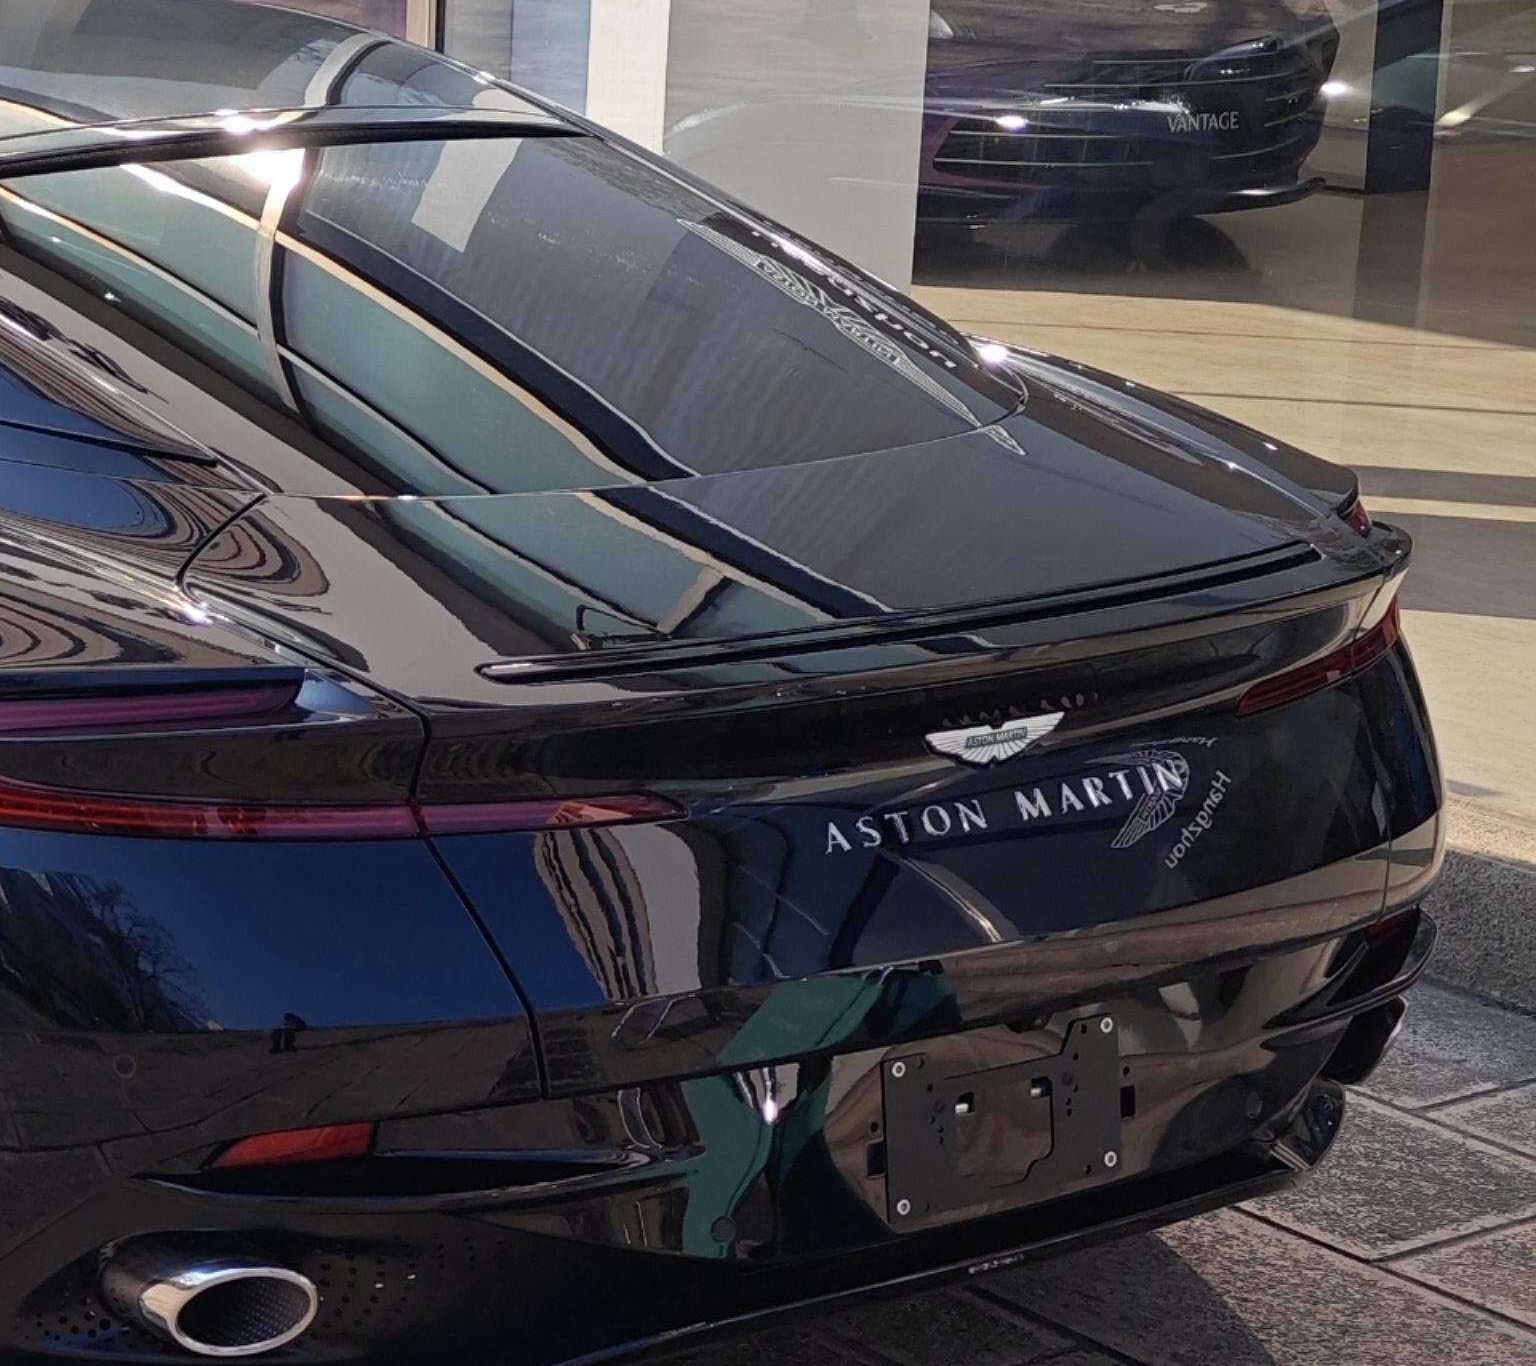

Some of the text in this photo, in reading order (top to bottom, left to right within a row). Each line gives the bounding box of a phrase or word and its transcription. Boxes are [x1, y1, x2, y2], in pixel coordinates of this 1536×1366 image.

[1167, 111, 1239, 133] VANTAGE
[825, 798, 988, 854] ASTON
[1014, 758, 1183, 822] MARTIN
